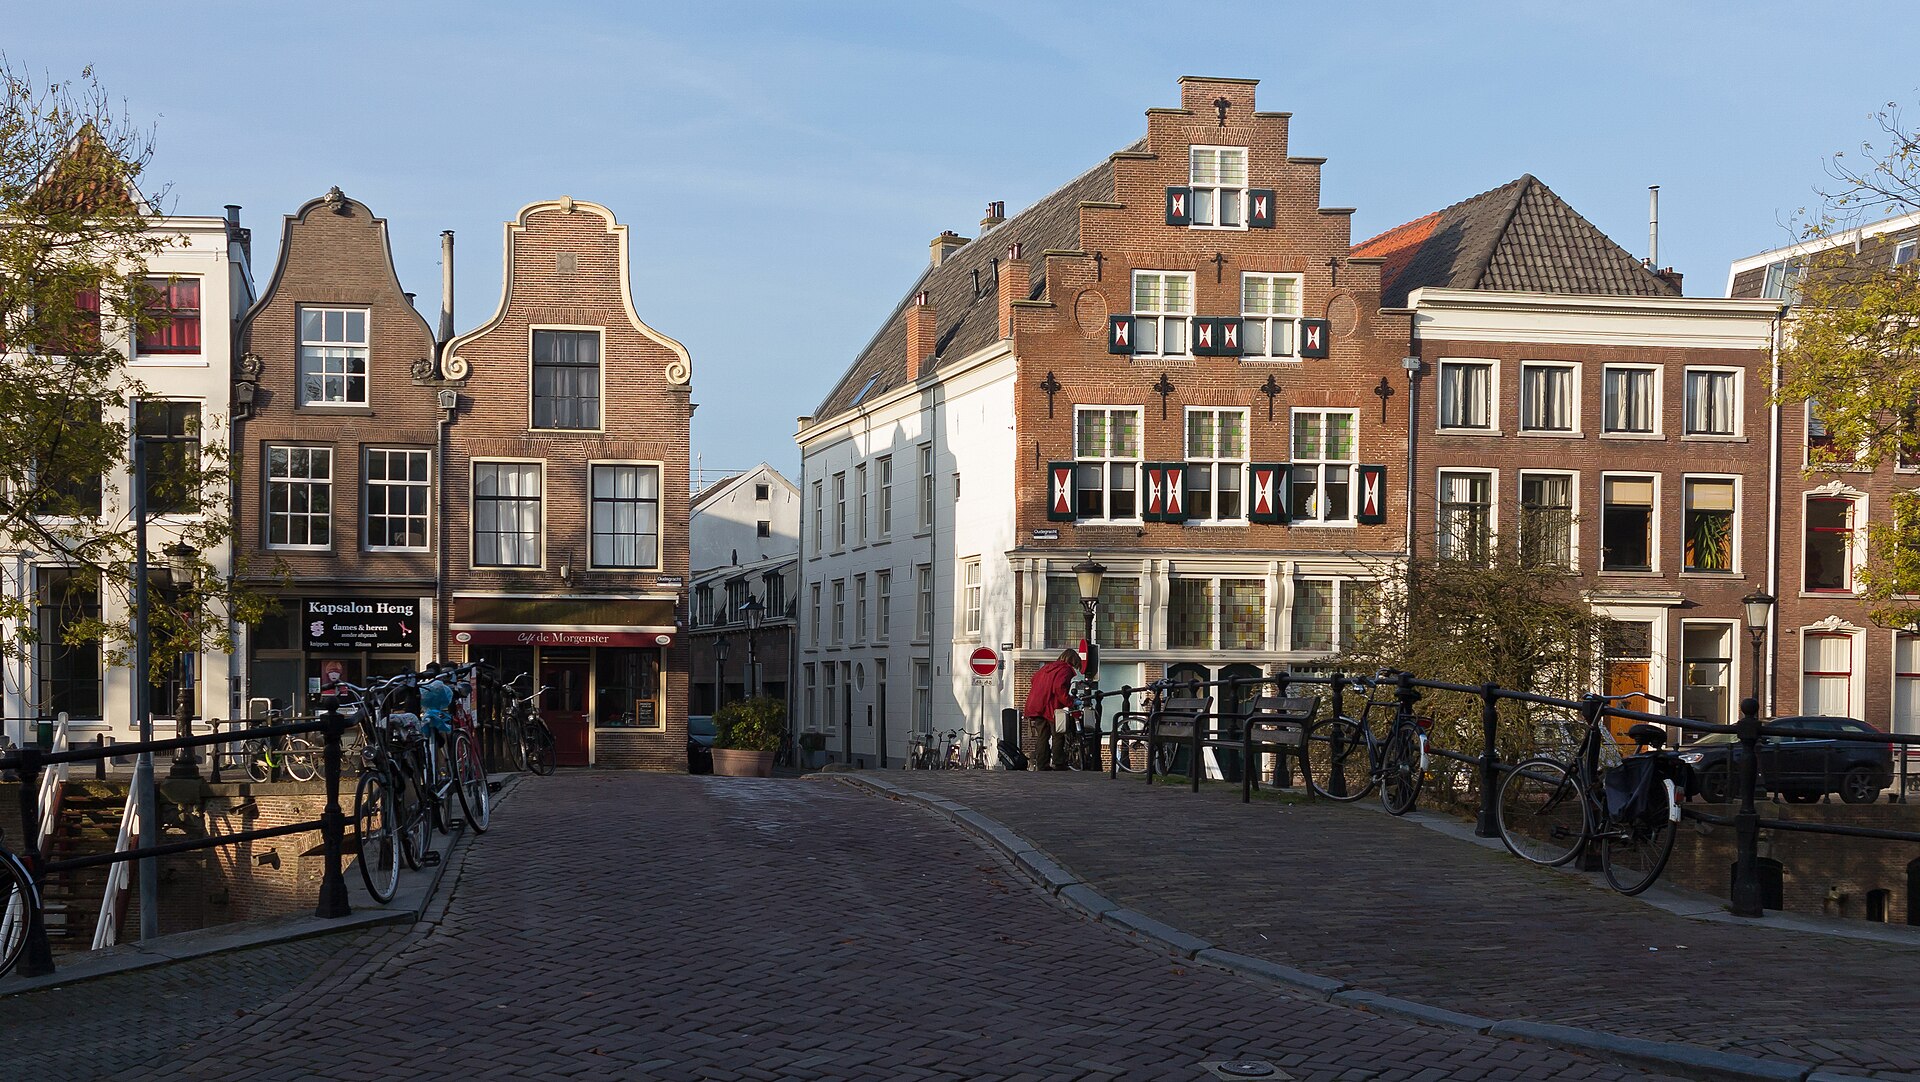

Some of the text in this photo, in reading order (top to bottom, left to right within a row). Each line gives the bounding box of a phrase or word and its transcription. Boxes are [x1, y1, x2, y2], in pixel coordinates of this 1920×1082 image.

[309, 602, 413, 616] Kapsalon Heng
[537, 632, 549, 643] de
[552, 632, 610, 644] Morgenster
